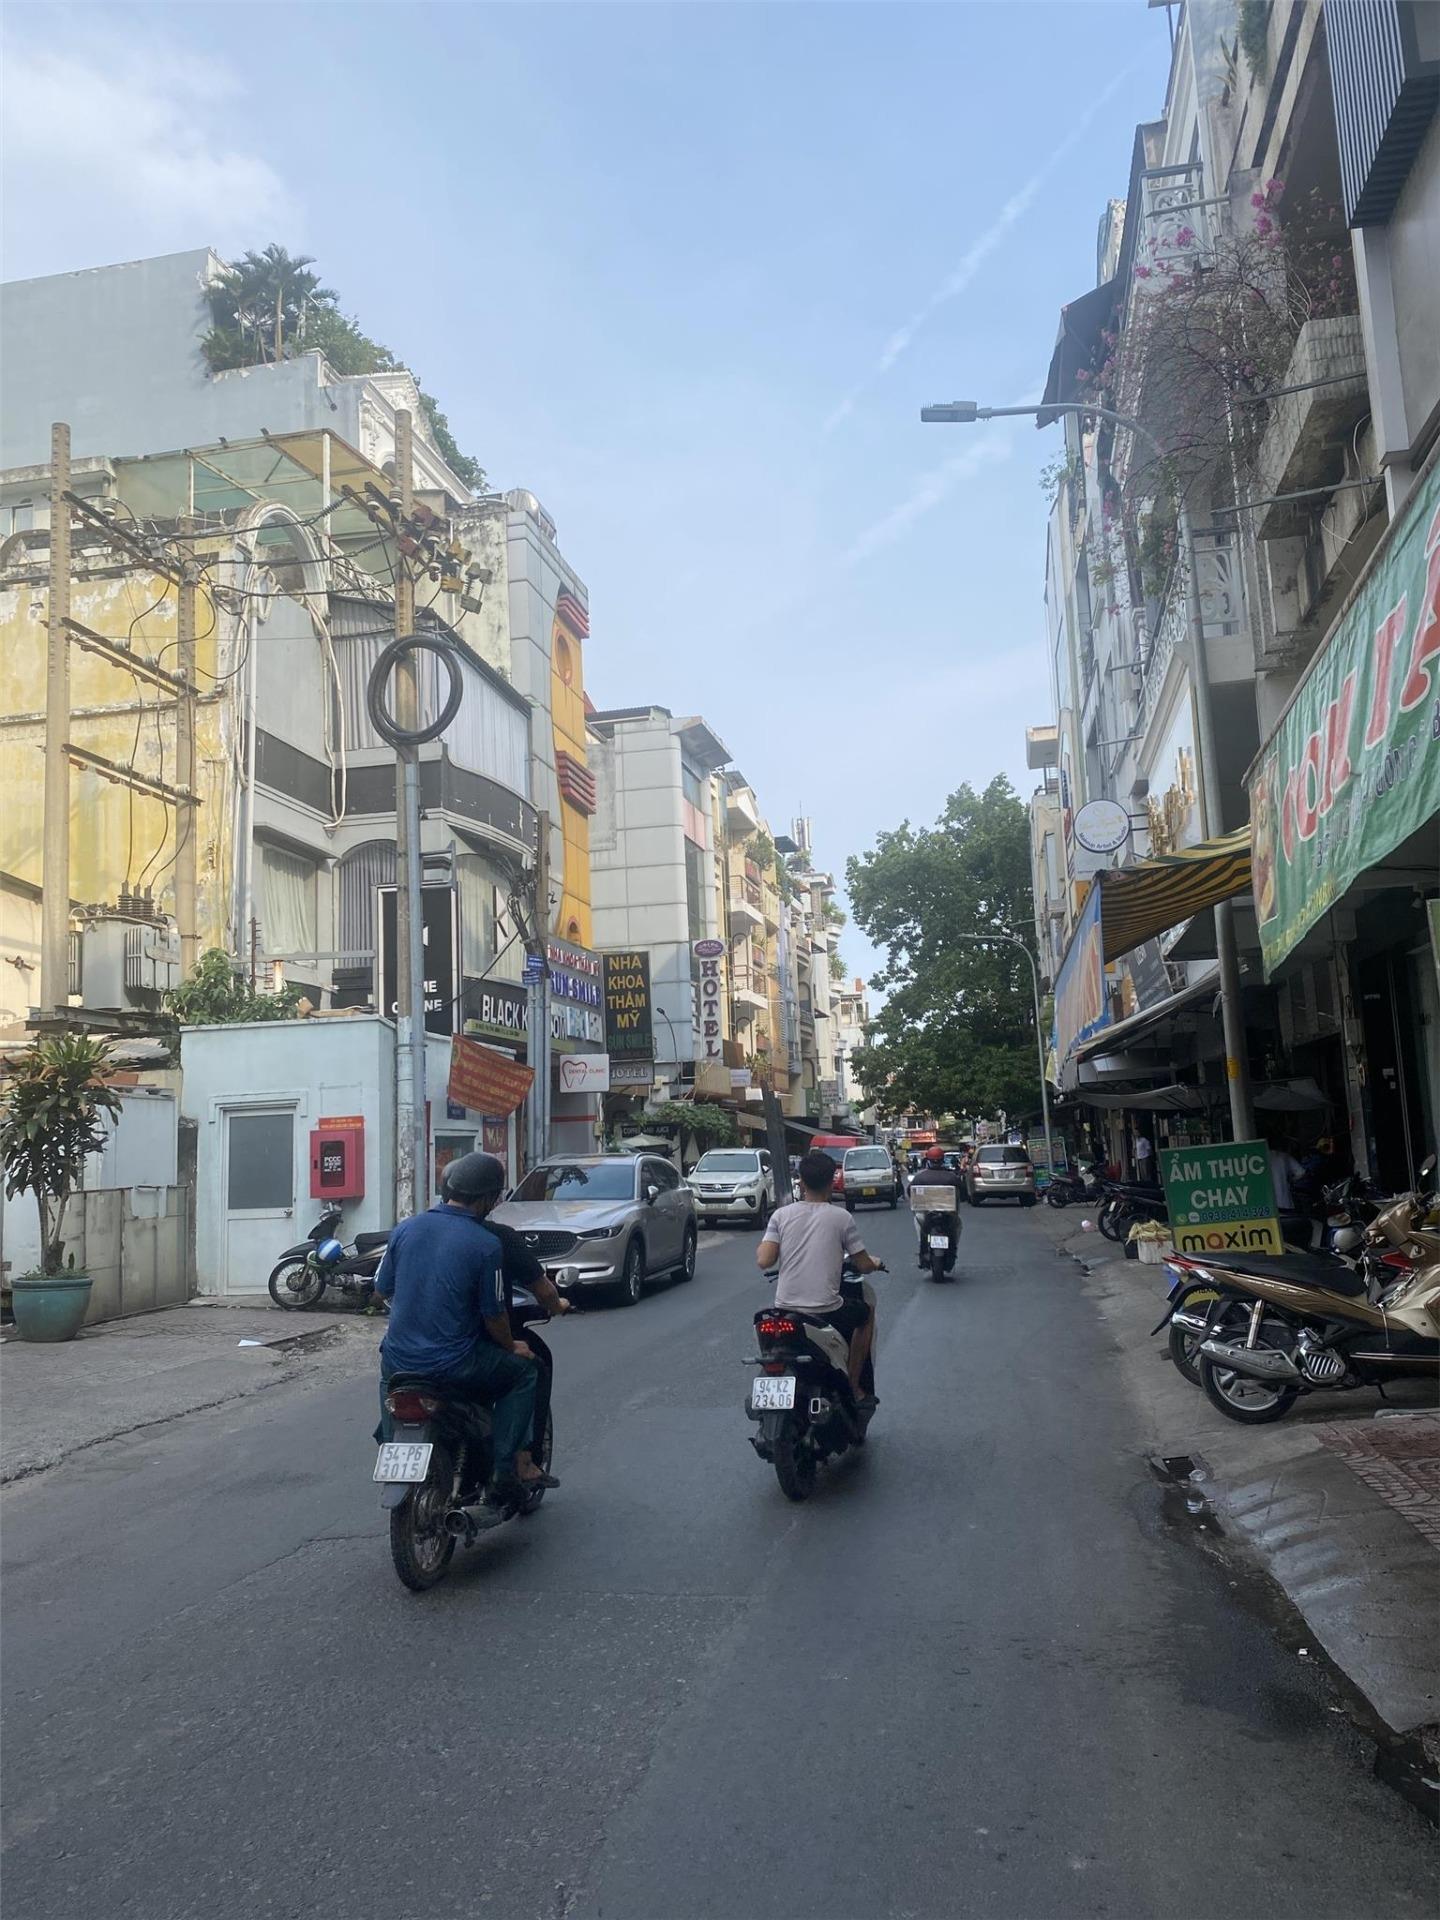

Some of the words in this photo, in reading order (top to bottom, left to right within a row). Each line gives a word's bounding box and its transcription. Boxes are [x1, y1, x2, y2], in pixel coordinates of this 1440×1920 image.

[608, 955, 642, 970] NHA
[608, 974, 645, 990] KHOA
[482, 994, 520, 1030] BLACK
[616, 1009, 640, 1028] MỸ
[700, 960, 721, 1057] HOTEL
[1169, 1153, 1202, 1183] ẨM
[1207, 1154, 1265, 1182] THỰC
[1190, 1186, 1249, 1209] CHAY
[1182, 1225, 1273, 1252] maxim
[381, 1463, 420, 1478] 3015
